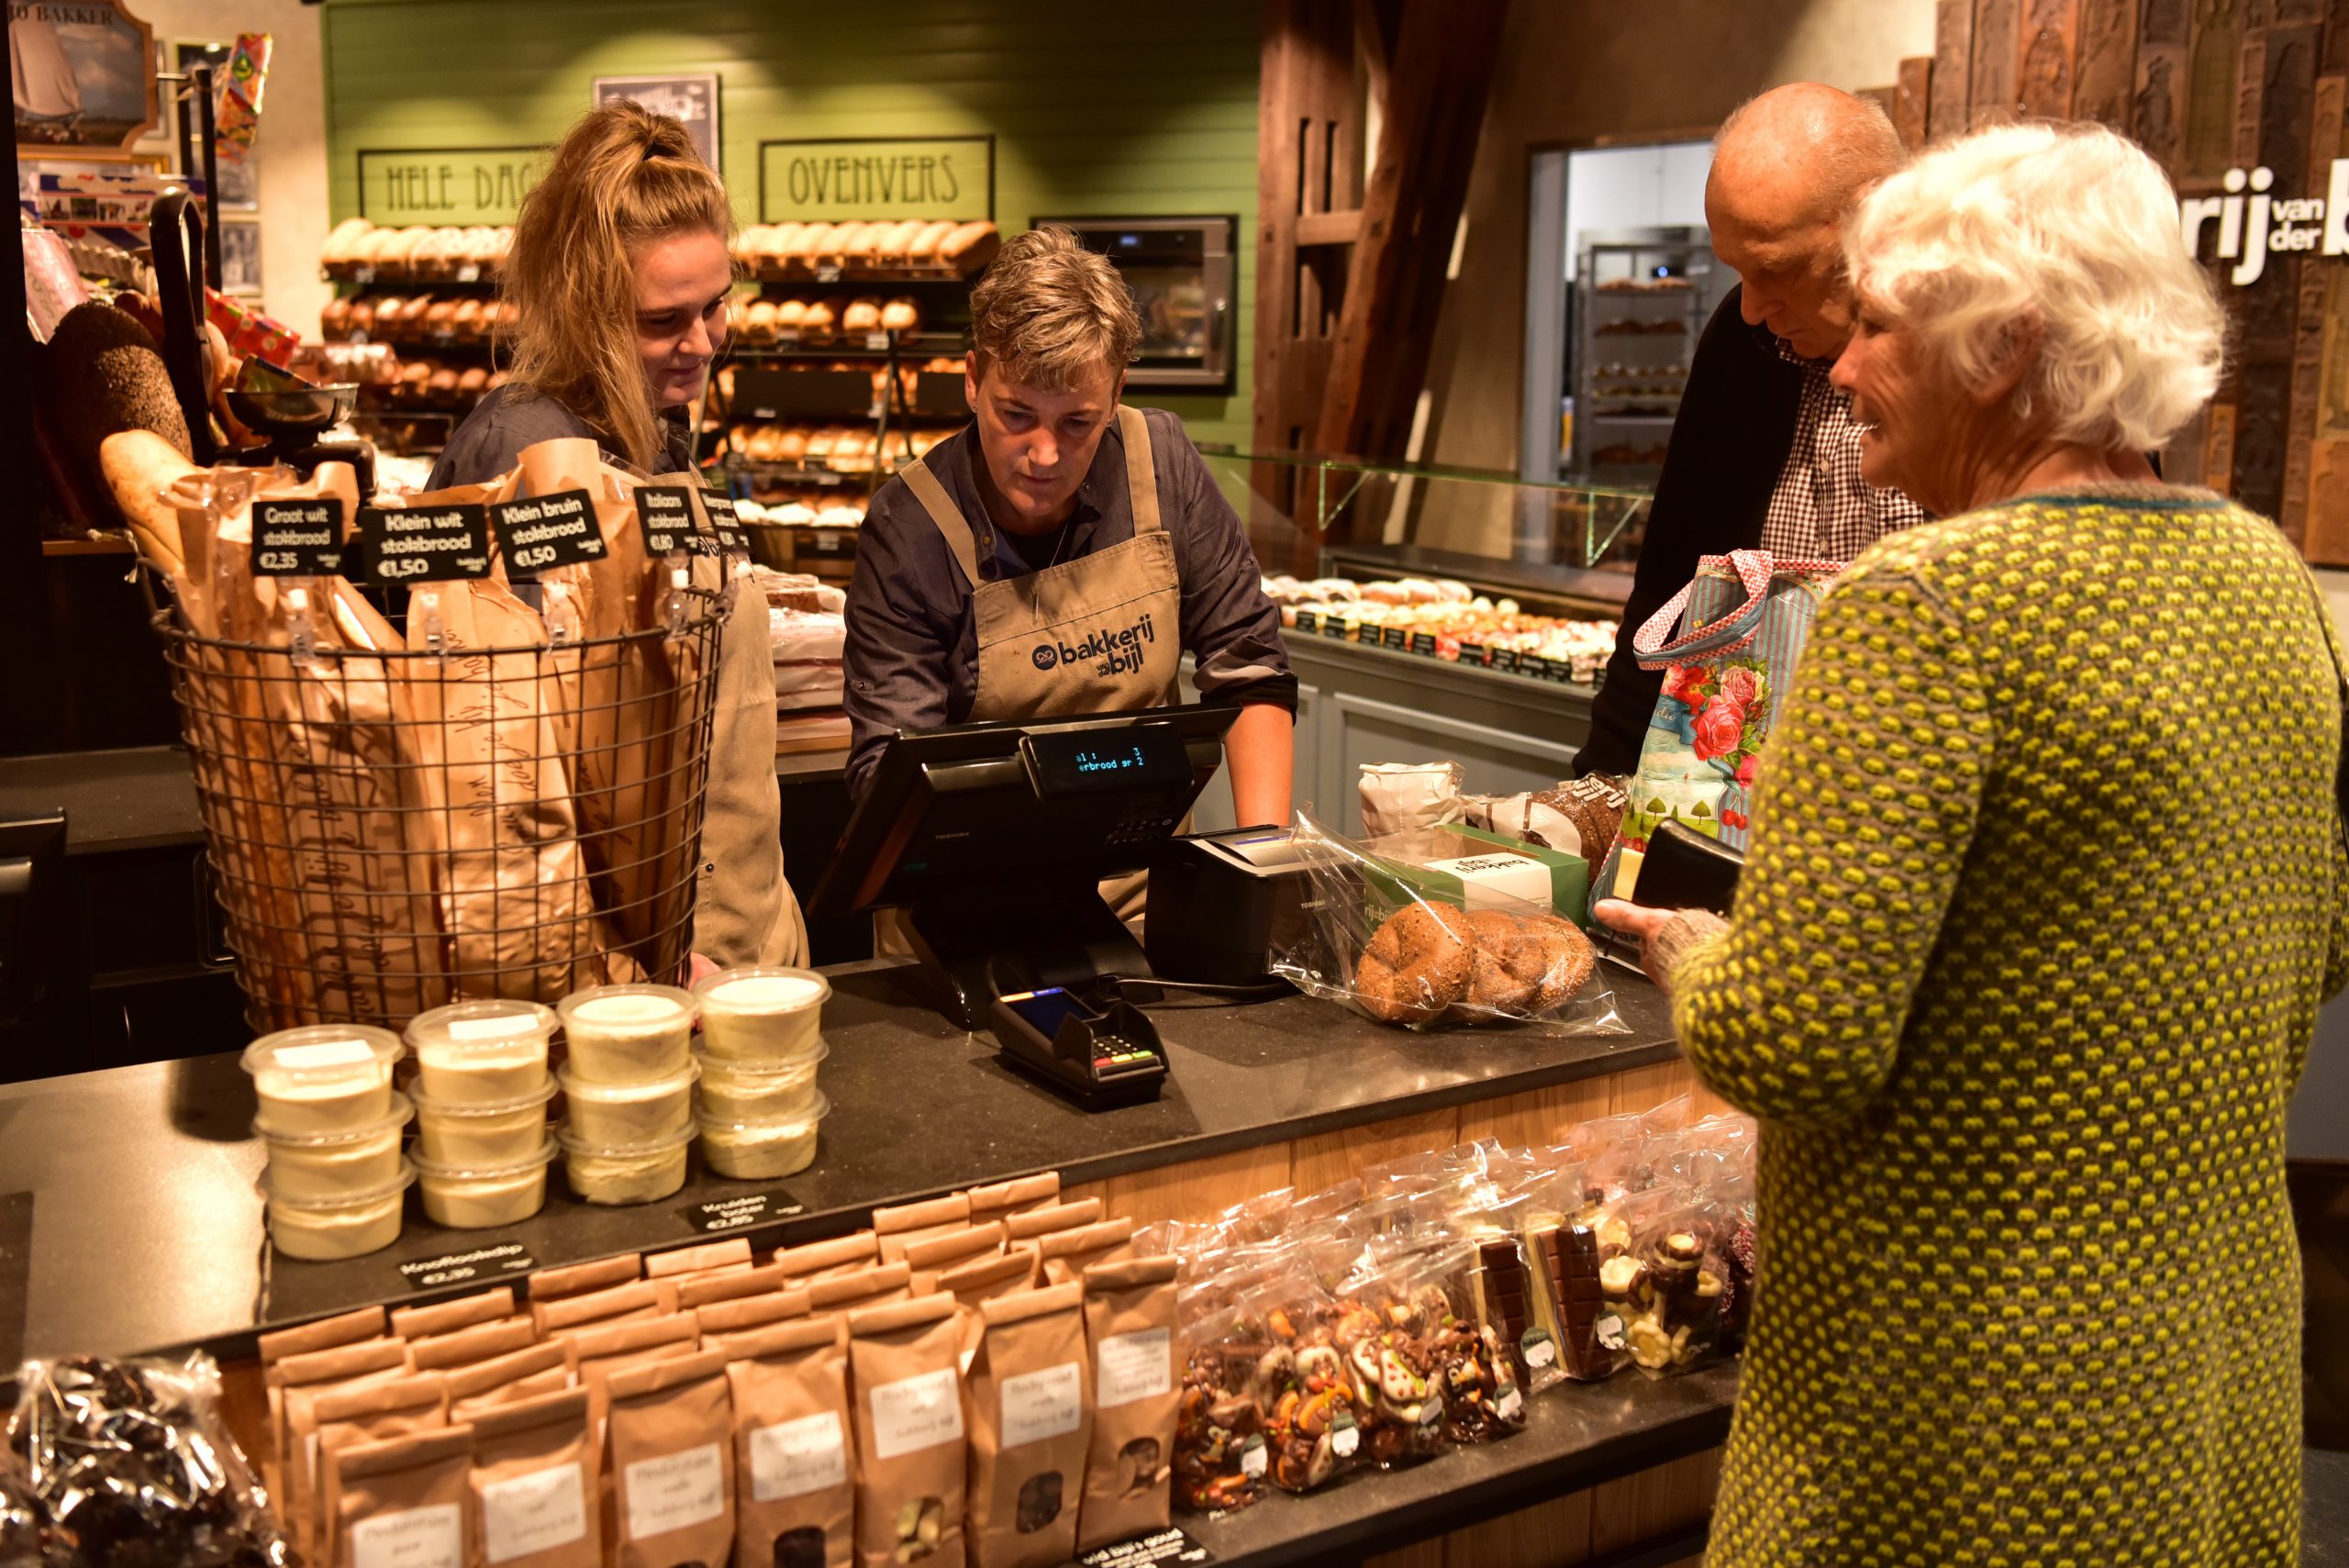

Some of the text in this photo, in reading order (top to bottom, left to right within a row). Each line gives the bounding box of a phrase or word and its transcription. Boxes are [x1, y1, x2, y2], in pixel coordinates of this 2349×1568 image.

[37, 6, 113, 25] BAKKER
[386, 165, 456, 210] HELE
[788, 154, 959, 205] OVENVERS
[2272, 198, 2325, 222] van
[2181, 166, 2274, 285] rij
[2268, 221, 2322, 251] der
[264, 506, 328, 524] Groot wit
[384, 512, 464, 531] Klein wit
[502, 497, 584, 525] Klein bruin
[263, 529, 330, 546] stokbrood
[511, 516, 587, 546] stokbrood
[380, 532, 472, 554] stokbrood
[259, 552, 298, 570] €2,35
[514, 545, 557, 567] €1,50
[377, 558, 429, 578] €1,50
[1058, 613, 1154, 665] bakkerij
[1108, 641, 1144, 675] bijl
[1137, 757, 1144, 765] 2
